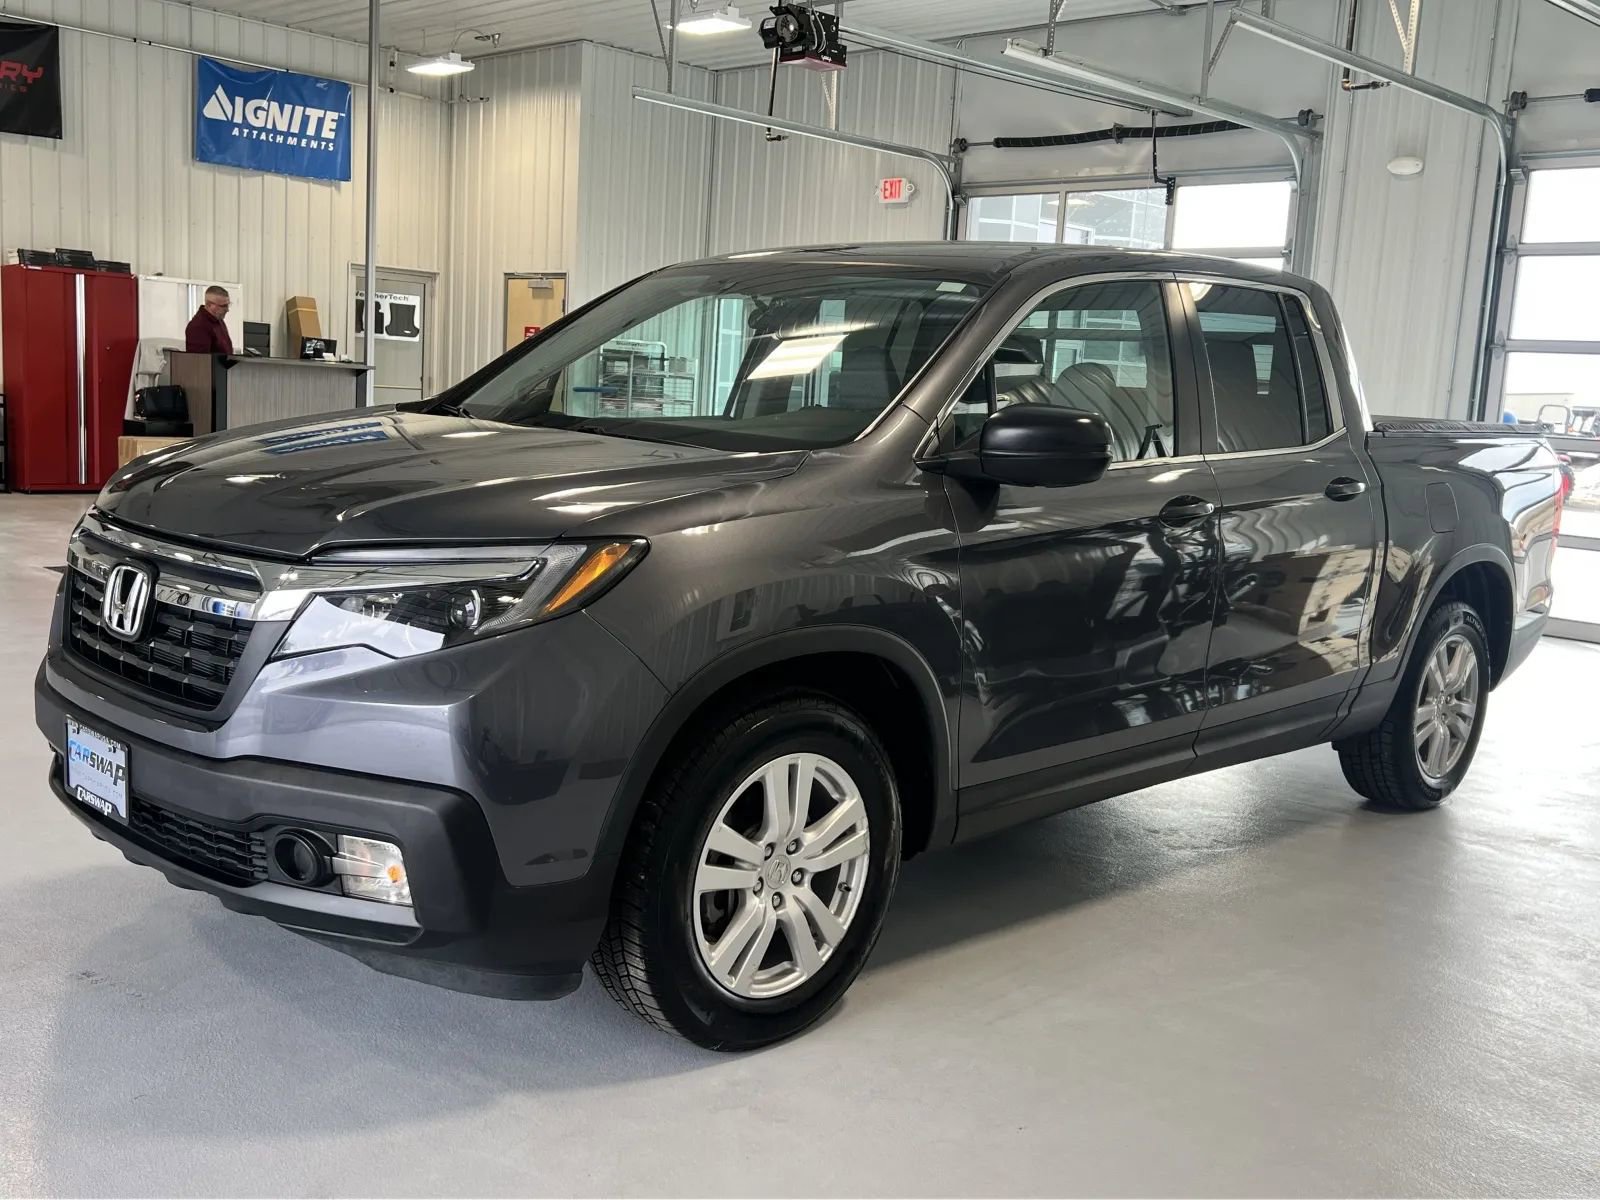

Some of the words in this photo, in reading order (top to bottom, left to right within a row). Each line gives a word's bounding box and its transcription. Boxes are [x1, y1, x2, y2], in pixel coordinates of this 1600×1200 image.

[232, 96, 340, 140] IGNITE
[231, 127, 335, 151] ATTACHMENTS
[883, 179, 902, 199] EXIT
[356, 290, 409, 302] eherTech
[69, 739, 126, 787] CARSWAP
[76, 786, 112, 816] CARSWAP
